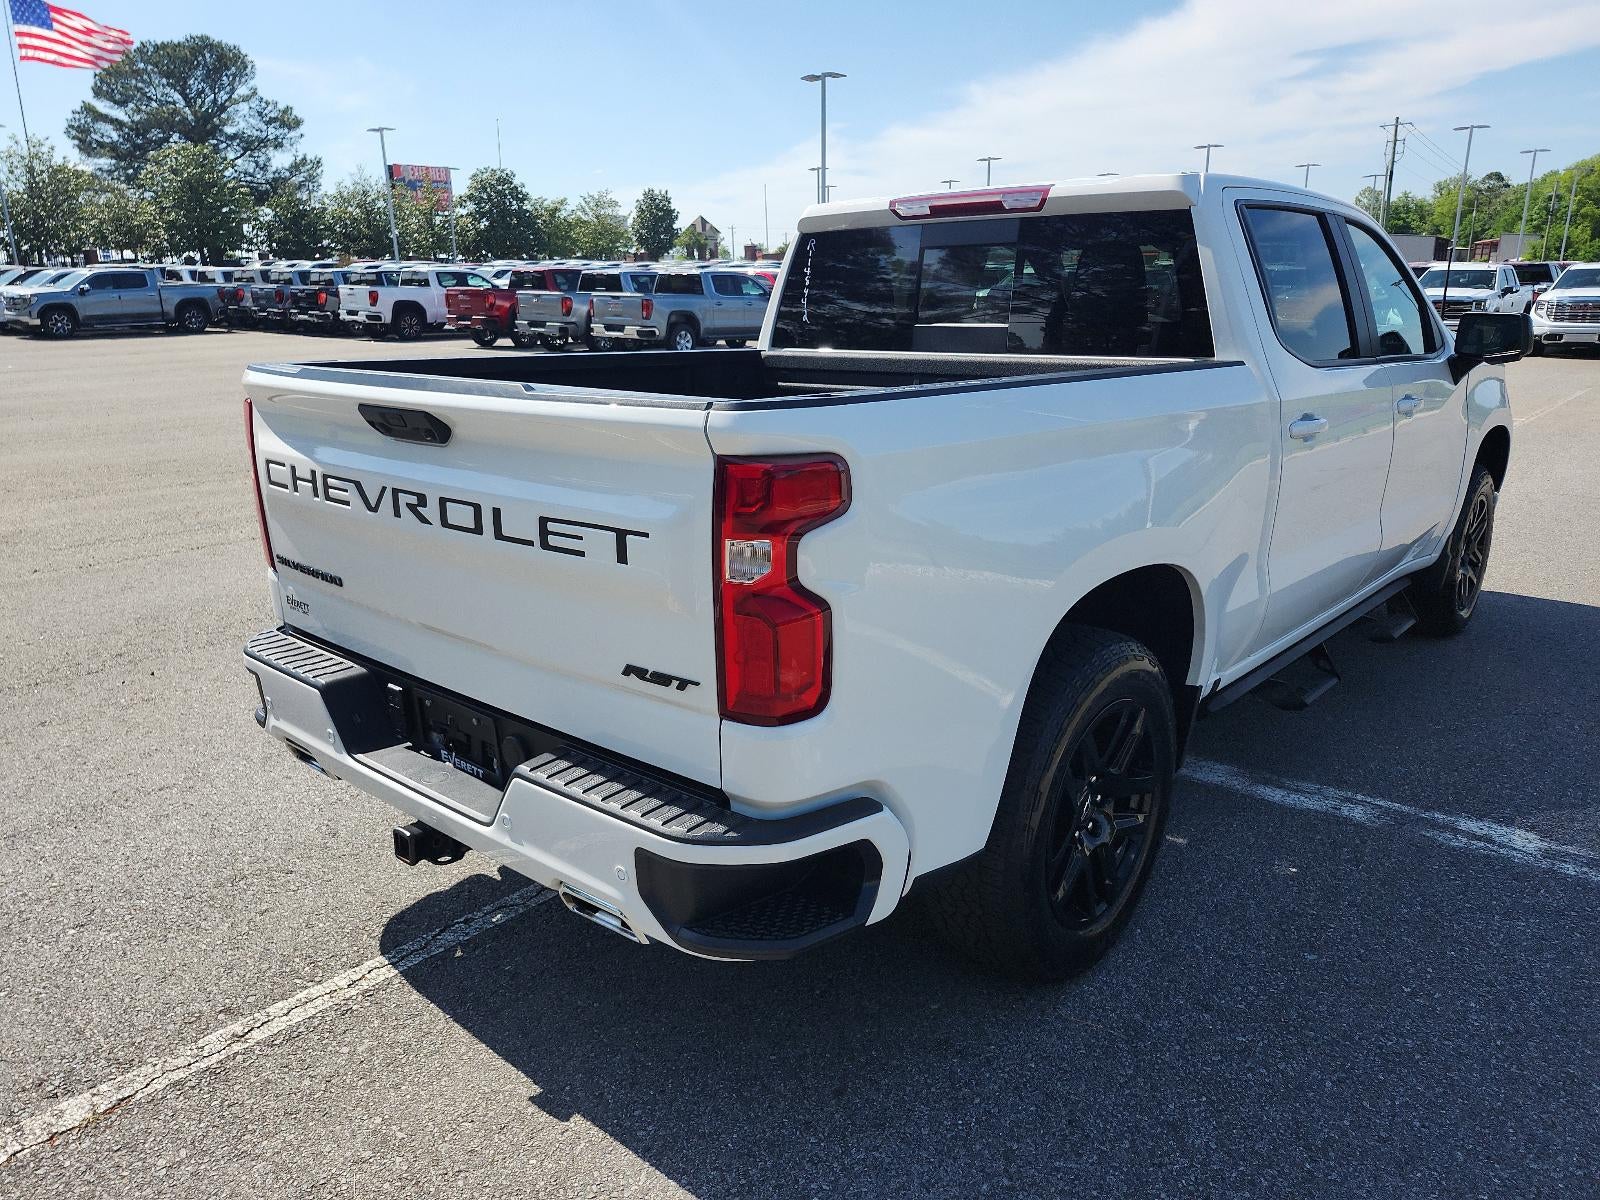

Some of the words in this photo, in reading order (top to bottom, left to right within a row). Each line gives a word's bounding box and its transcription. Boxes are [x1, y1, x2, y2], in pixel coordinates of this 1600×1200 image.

[266, 459, 650, 565] CHEVROLET
[621, 663, 701, 692] RST
[440, 750, 483, 778] EVERETT
